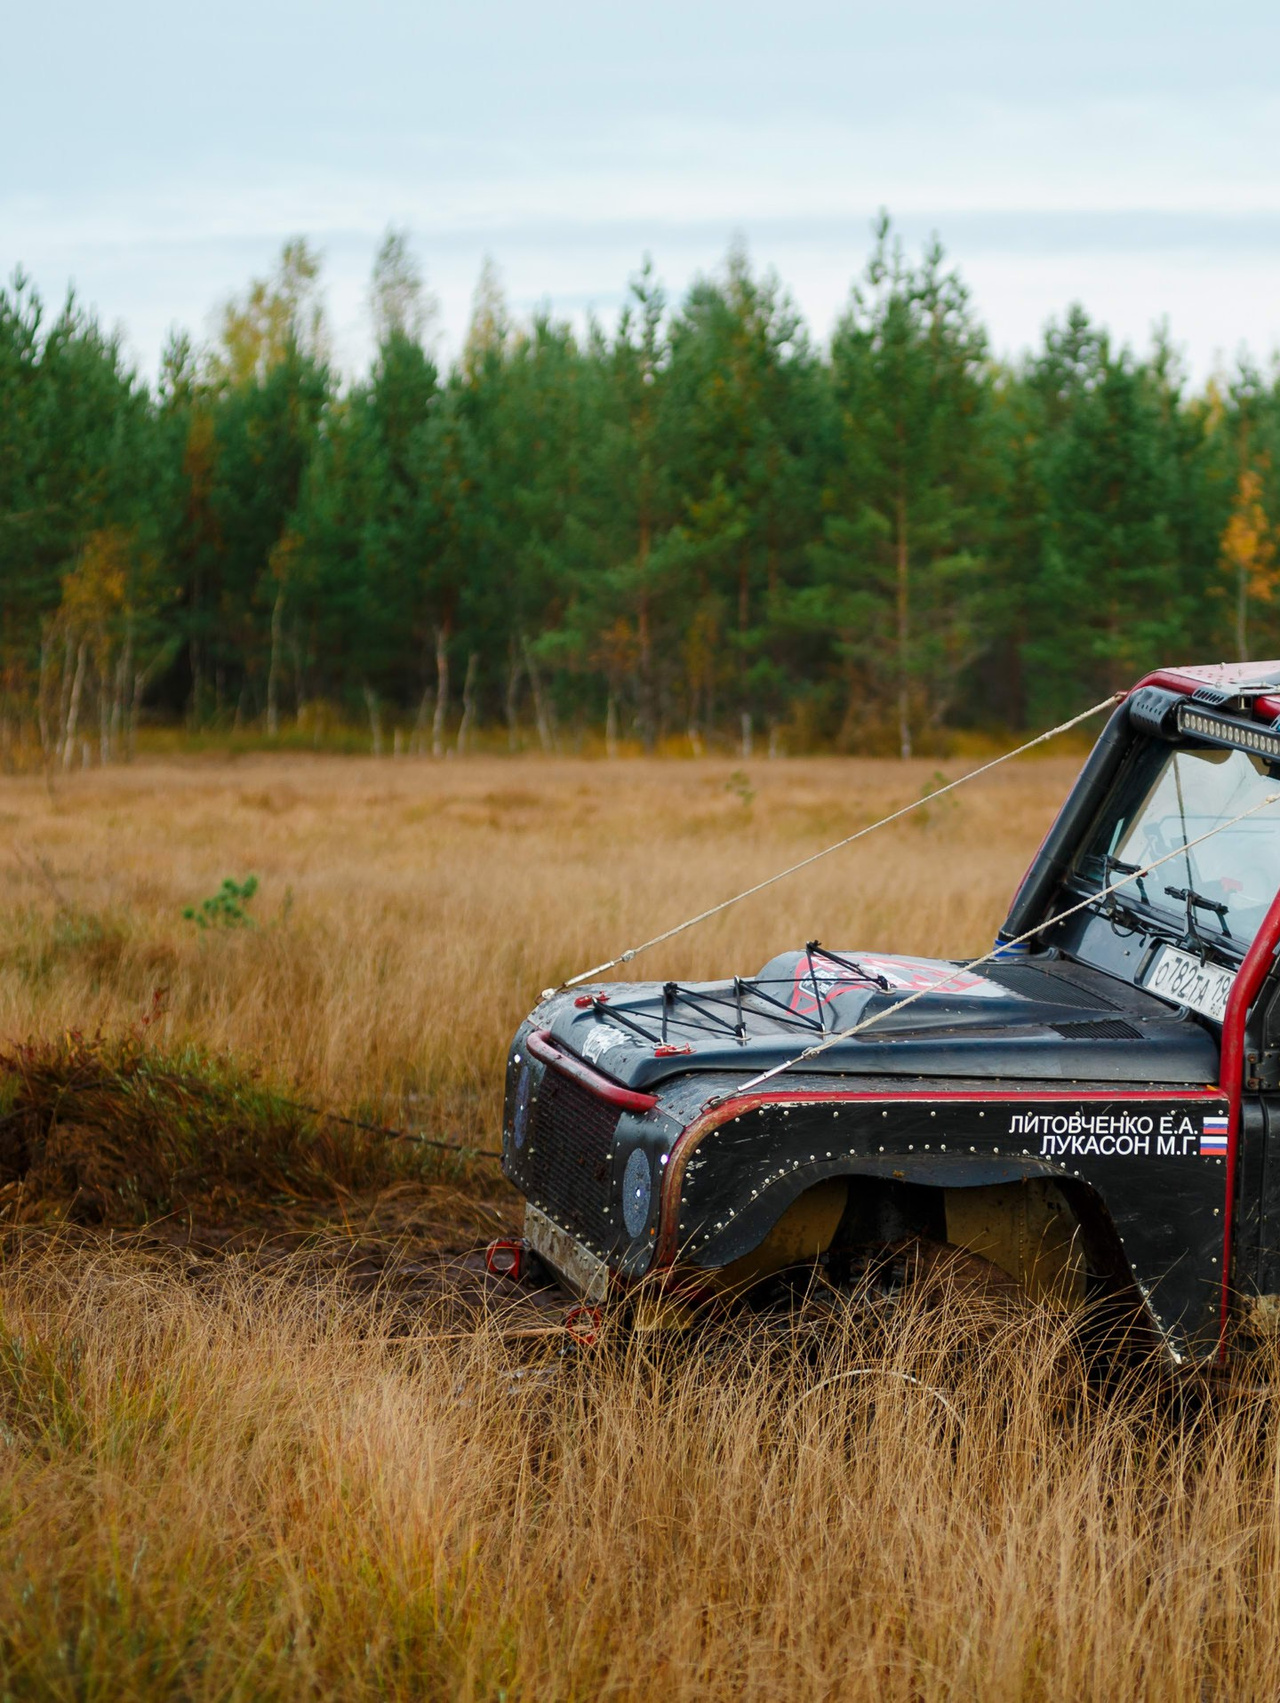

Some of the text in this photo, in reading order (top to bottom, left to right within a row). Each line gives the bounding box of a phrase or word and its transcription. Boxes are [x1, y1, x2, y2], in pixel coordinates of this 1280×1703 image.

[1008, 1115, 1199, 1134] ЛИТОВЧЕНКО Е.А.
[1039, 1135, 1198, 1156] ЛУКАСОН М.Г.
